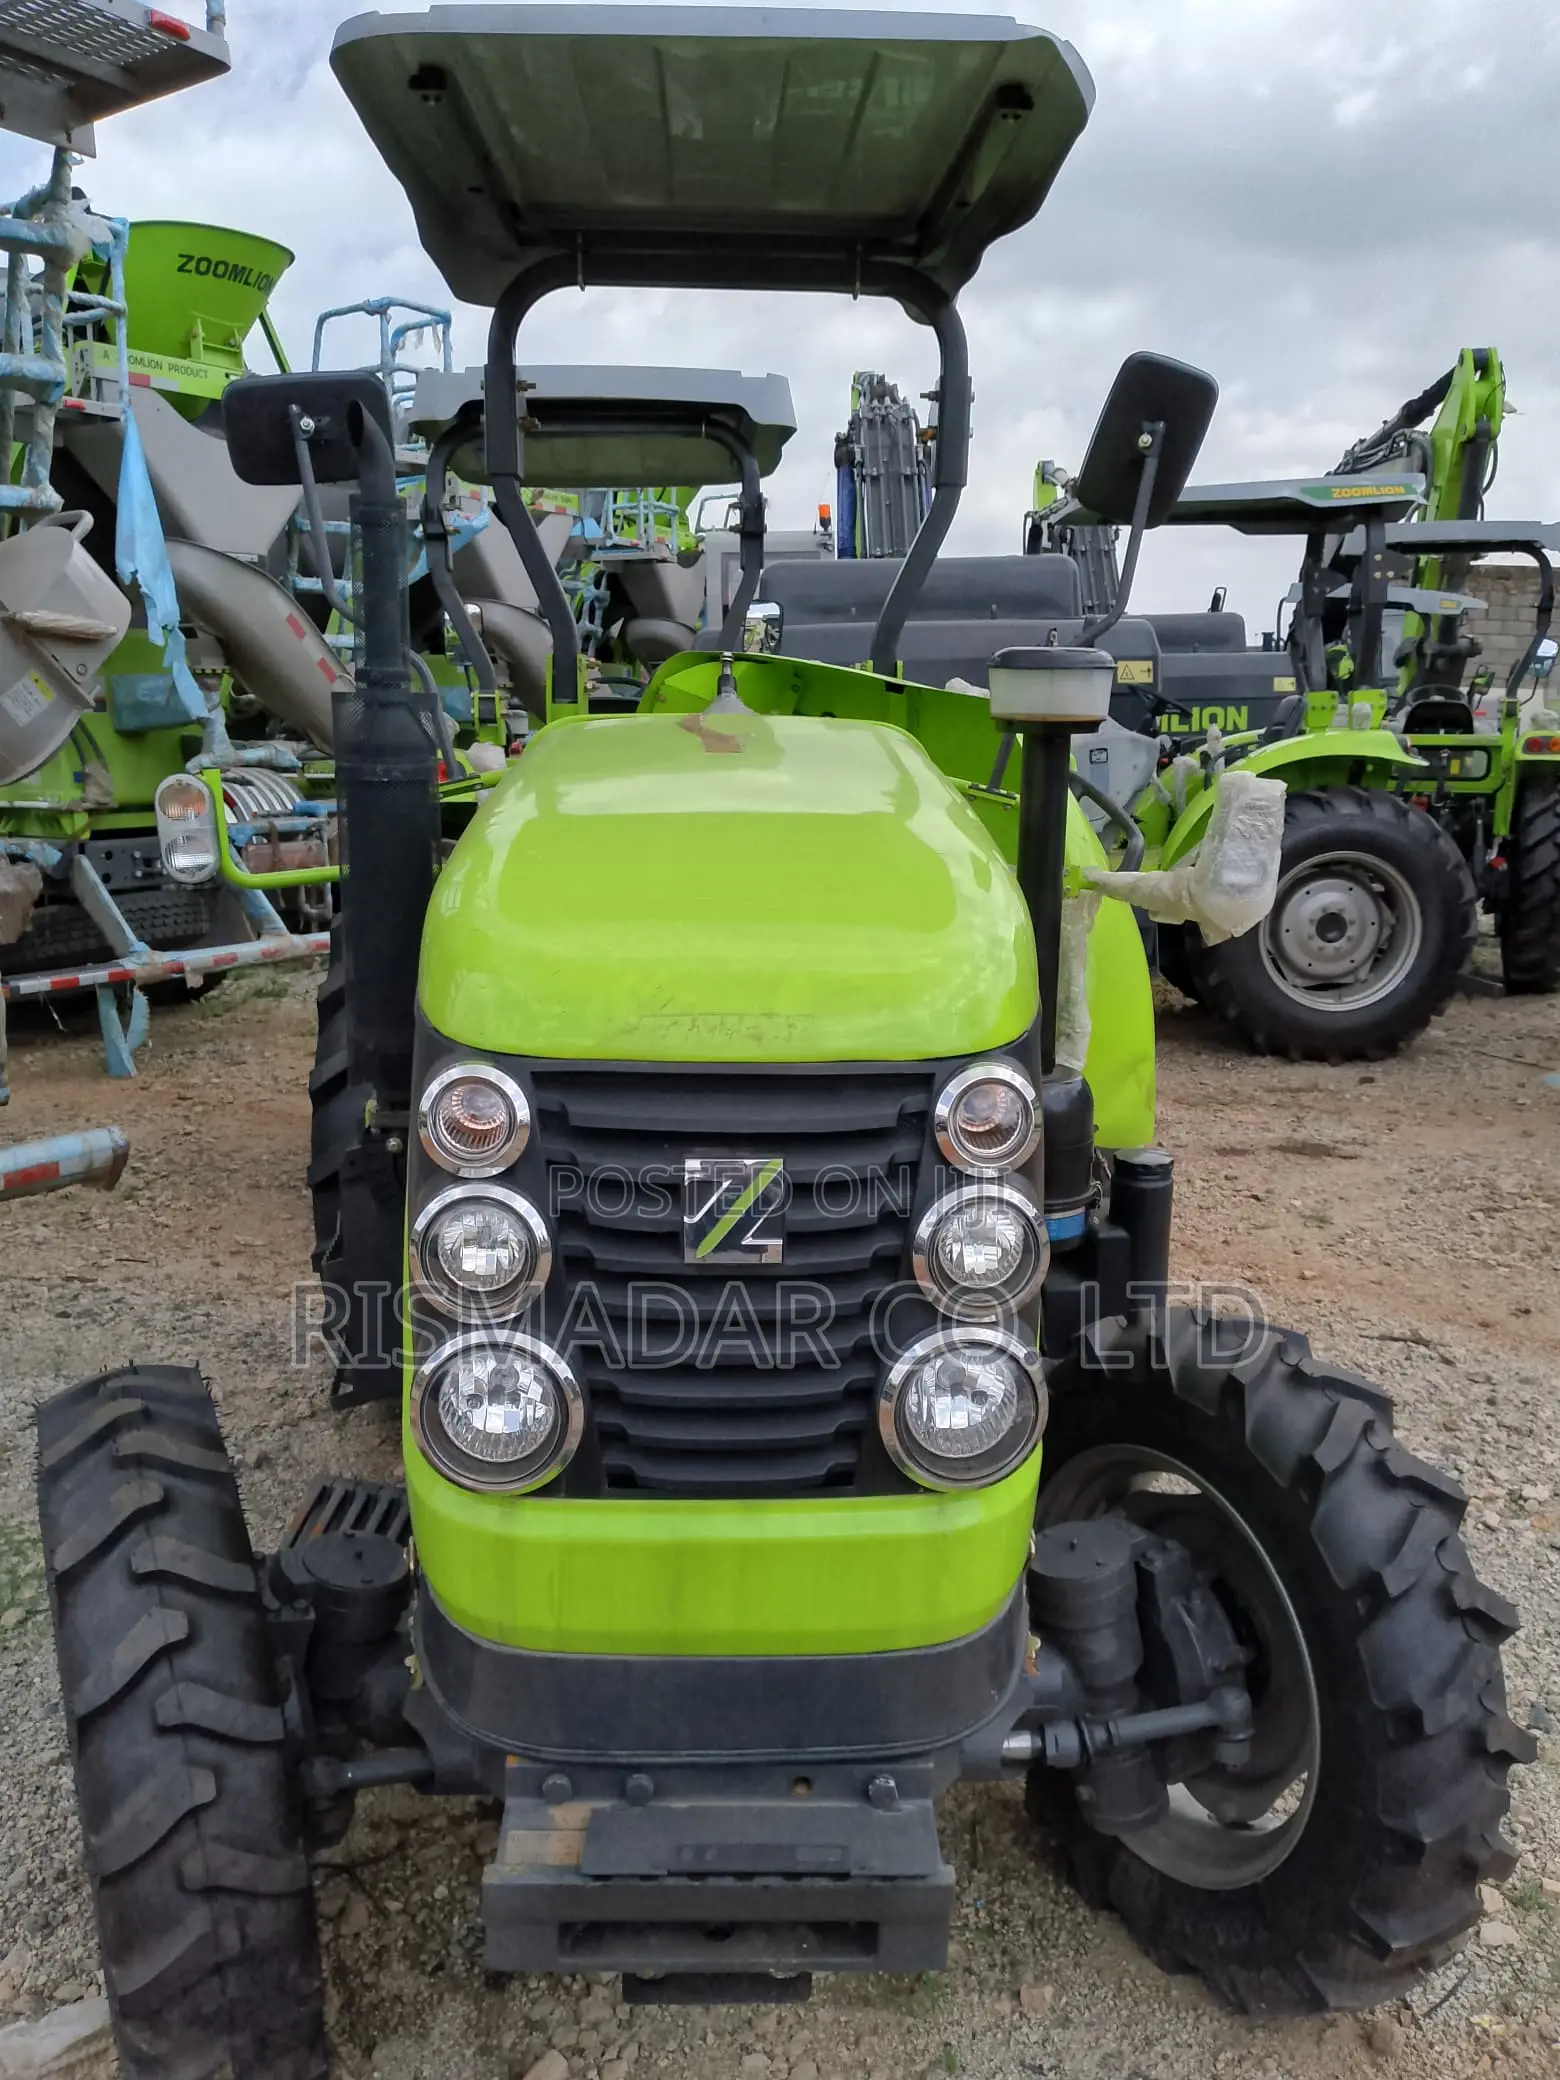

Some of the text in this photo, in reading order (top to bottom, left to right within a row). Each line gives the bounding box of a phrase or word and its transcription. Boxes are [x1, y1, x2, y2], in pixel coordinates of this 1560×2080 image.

[128, 354, 163, 371] OMLION
[168, 363, 208, 379] PRODUCT
[1331, 485, 1406, 499] ZOOMLION
[1159, 705, 1249, 733] LION
